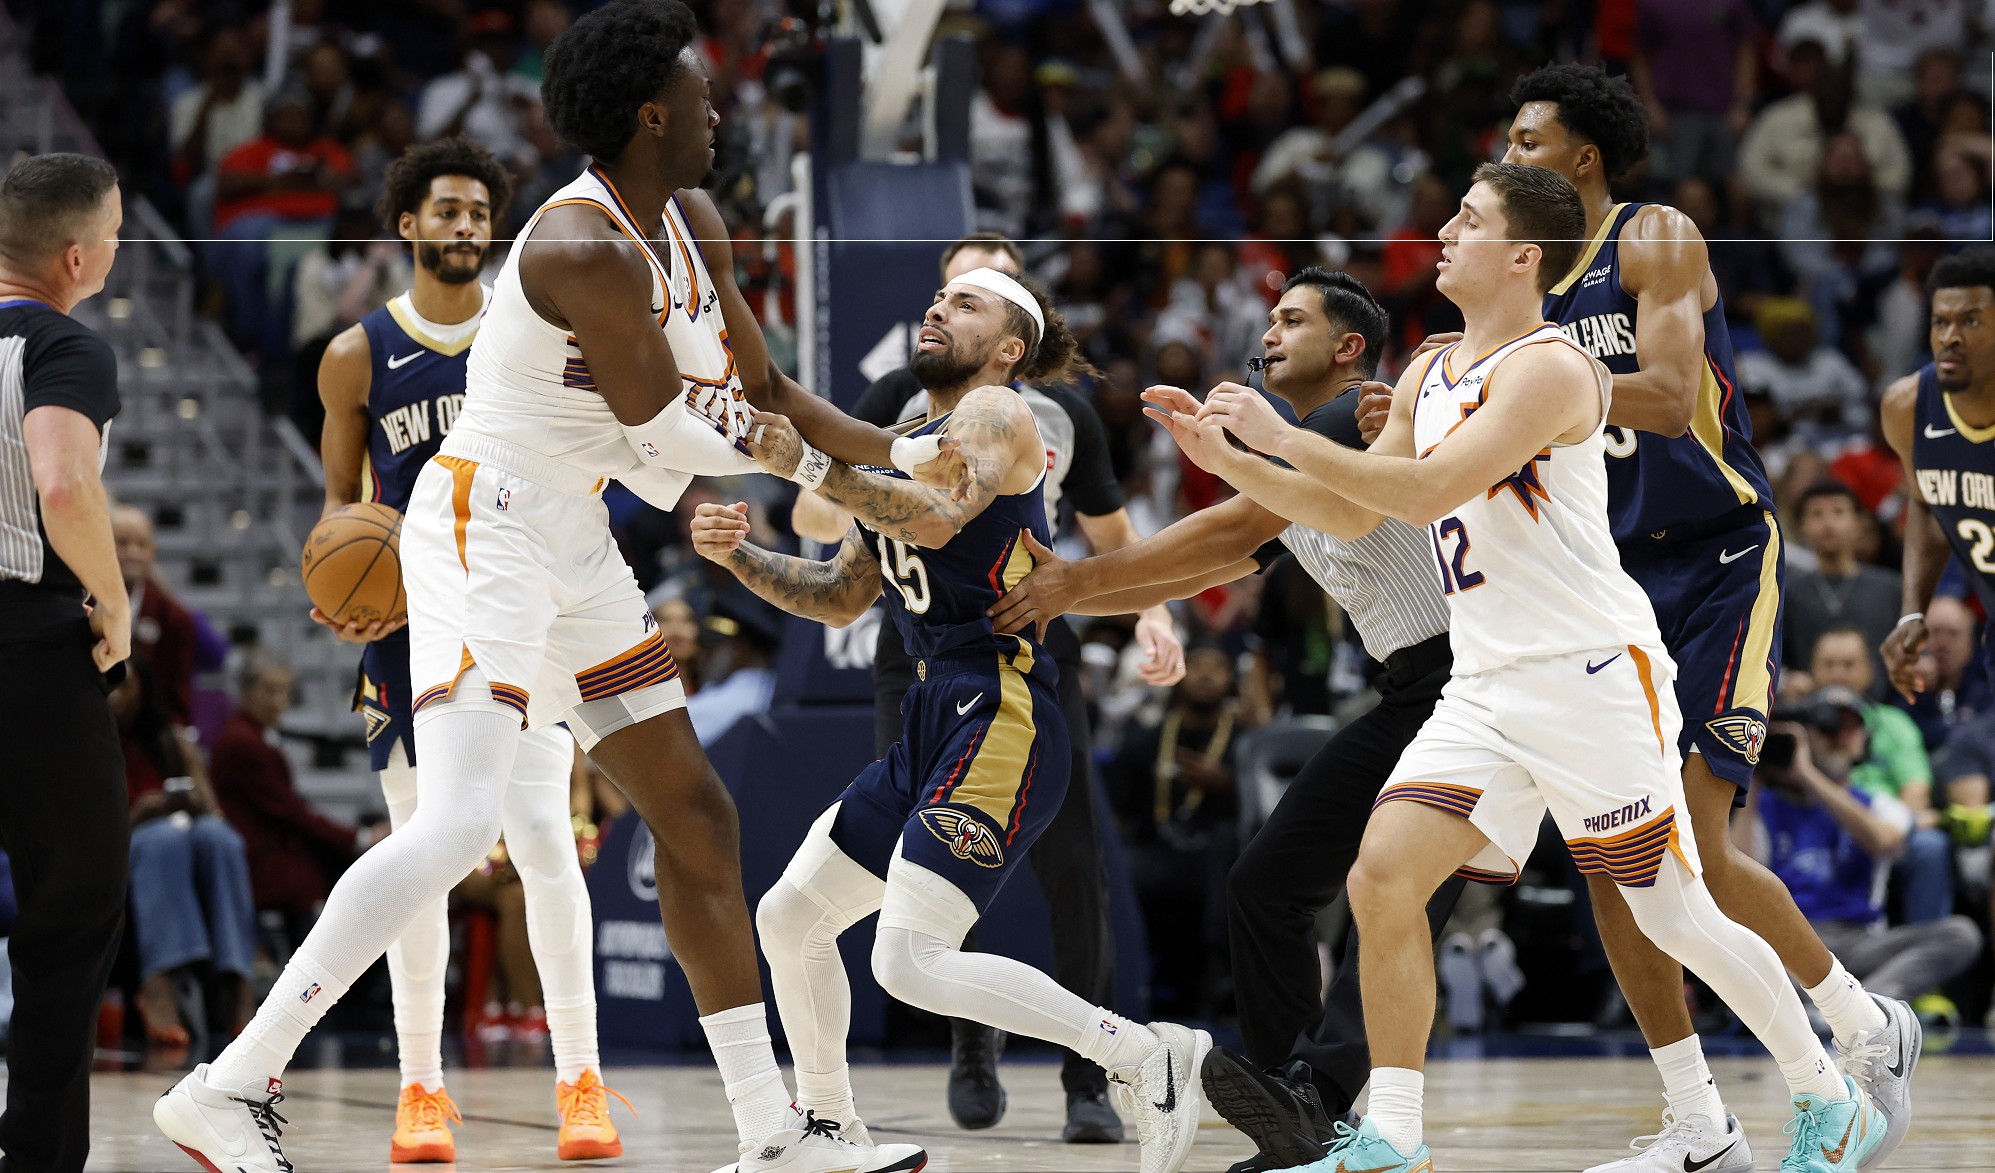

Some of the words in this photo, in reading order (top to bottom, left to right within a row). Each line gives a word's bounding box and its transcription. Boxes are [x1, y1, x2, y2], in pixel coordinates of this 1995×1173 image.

[1581, 265, 1612, 285] NEWAGE
[1584, 277, 1606, 288] GARAGE
[380, 399, 431, 456] NEW
[1915, 469, 1958, 506] NEW
[1430, 516, 1487, 596] 12
[1957, 518, 1995, 574] 2
[876, 533, 932, 615] 15
[1583, 794, 1653, 834] PHOENIX
